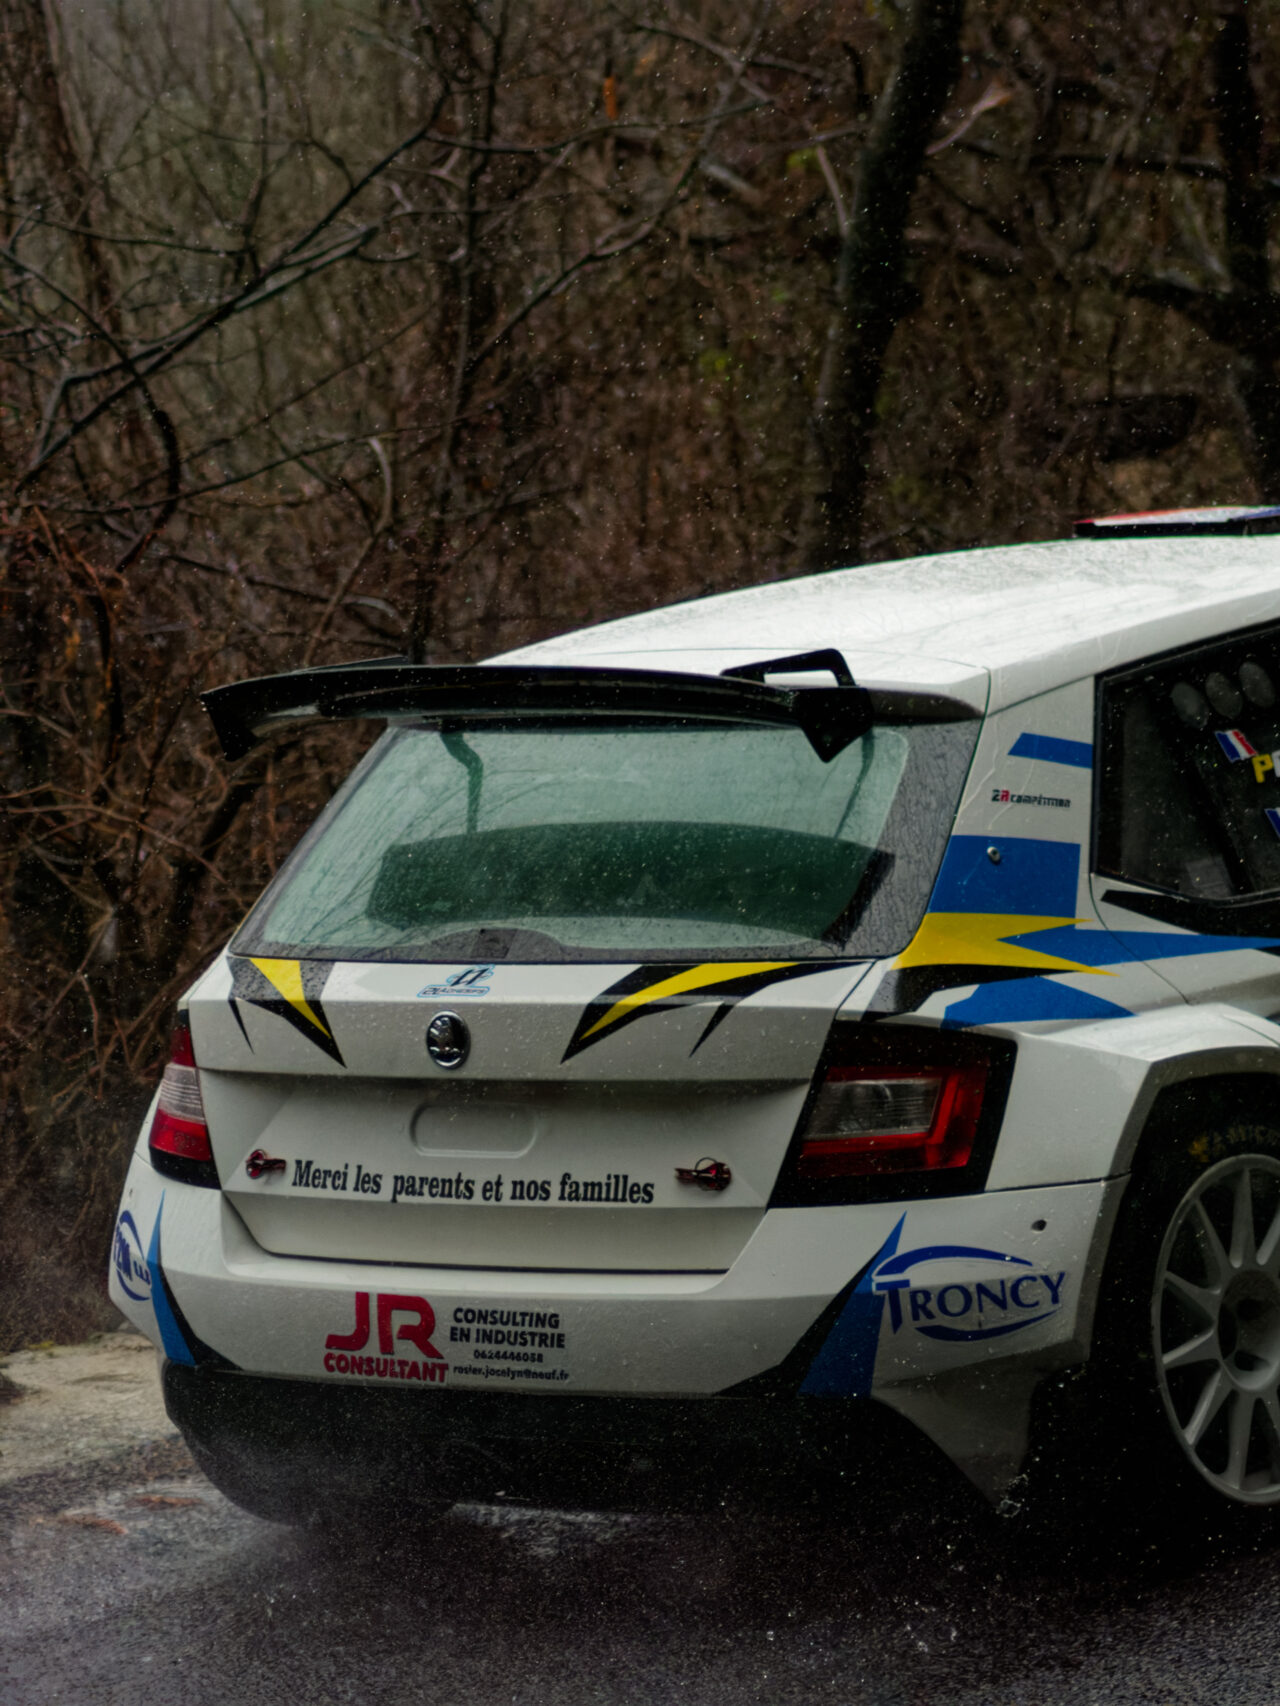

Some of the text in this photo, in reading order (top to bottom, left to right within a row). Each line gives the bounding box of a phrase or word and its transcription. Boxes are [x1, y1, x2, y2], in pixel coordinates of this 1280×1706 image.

[291, 1159, 655, 1204] Merci les parents et nos familles
[453, 1307, 560, 1329] CONSULTING
[875, 1272, 1066, 1335] TRONCY
[325, 1291, 444, 1359] JR
[450, 1326, 566, 1349] EN INDUSTRIE
[323, 1352, 449, 1383] CONSULTANT
